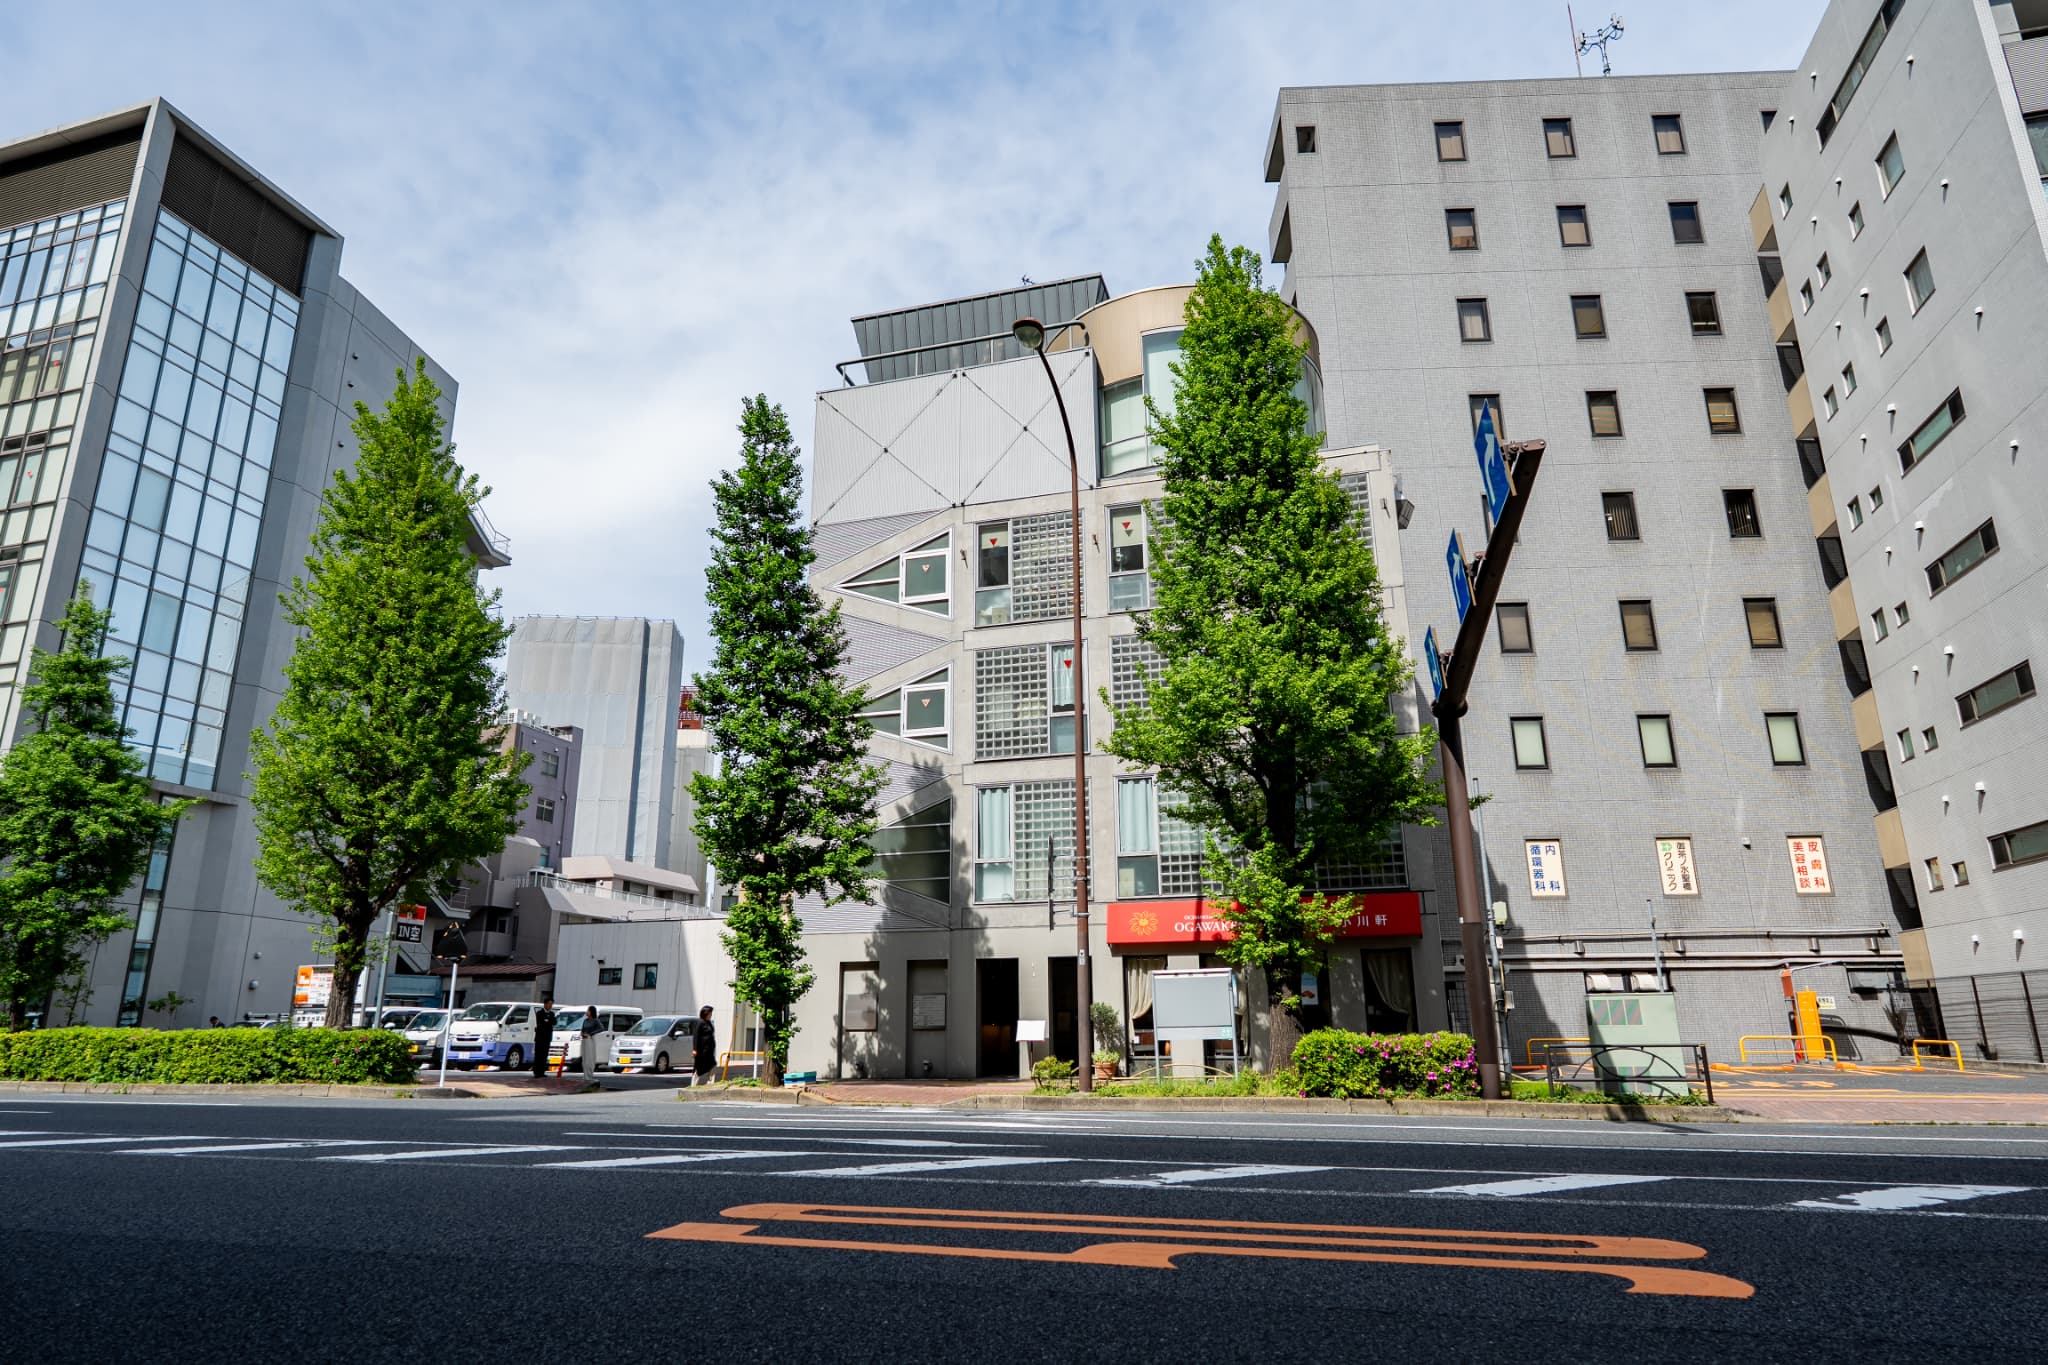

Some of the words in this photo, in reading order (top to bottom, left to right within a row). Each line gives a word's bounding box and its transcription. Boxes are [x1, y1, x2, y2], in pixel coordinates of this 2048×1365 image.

[1529, 844, 1546, 891] 循環器科
[1545, 845, 1561, 891] 内科
[1663, 852, 1678, 891] クリニック
[1792, 841, 1812, 889] 美容相談
[1808, 841, 1826, 889] 皮膚科
